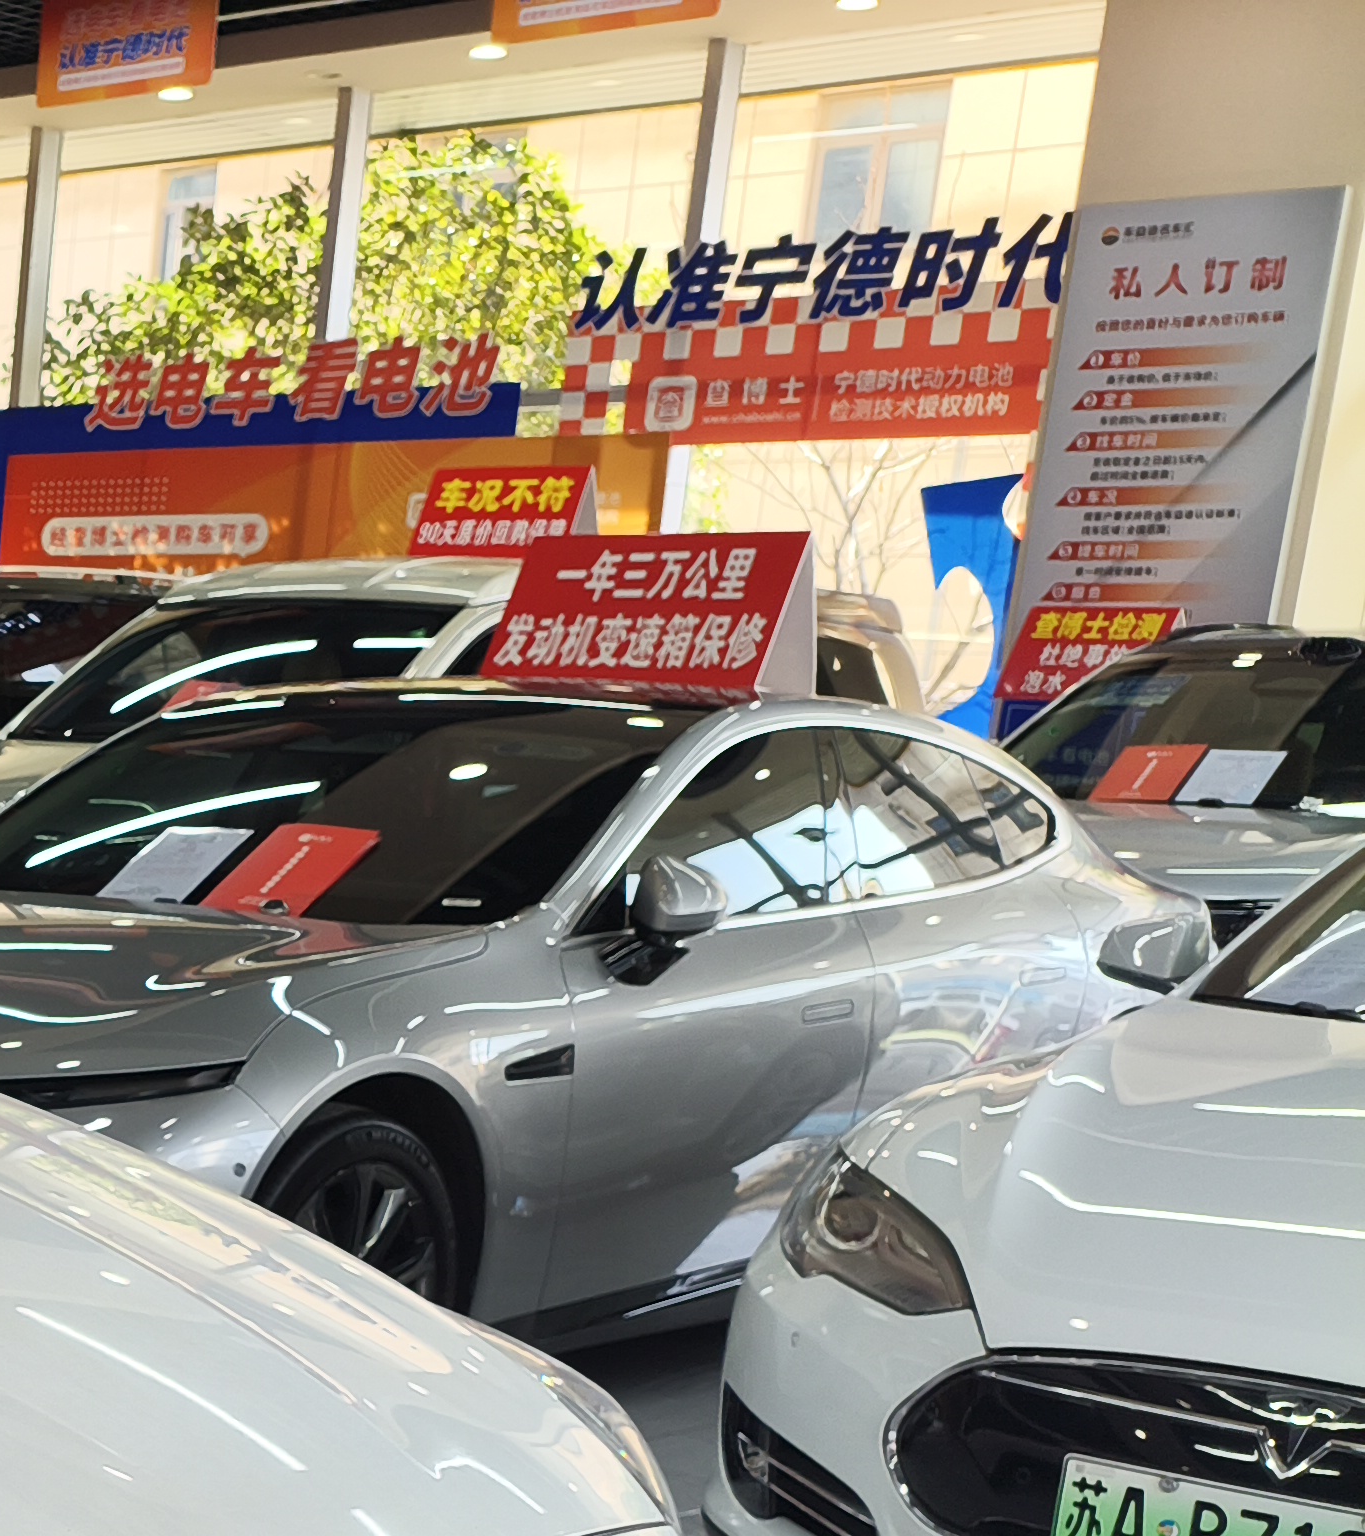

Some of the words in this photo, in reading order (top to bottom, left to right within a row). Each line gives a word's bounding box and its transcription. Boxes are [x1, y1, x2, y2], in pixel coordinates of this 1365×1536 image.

[1109, 256, 1287, 300] 私人订制
[84, 332, 501, 432] 选电车看电池
[834, 362, 1014, 394] 宁德时代动力电池
[830, 391, 1010, 421] 检测技术授权机构
[435, 477, 574, 513] 车况不符
[556, 548, 757, 602] 一年三万公里
[492, 612, 767, 669] 发动机变速箱保修
[1031, 611, 1167, 642] 查博士检测
